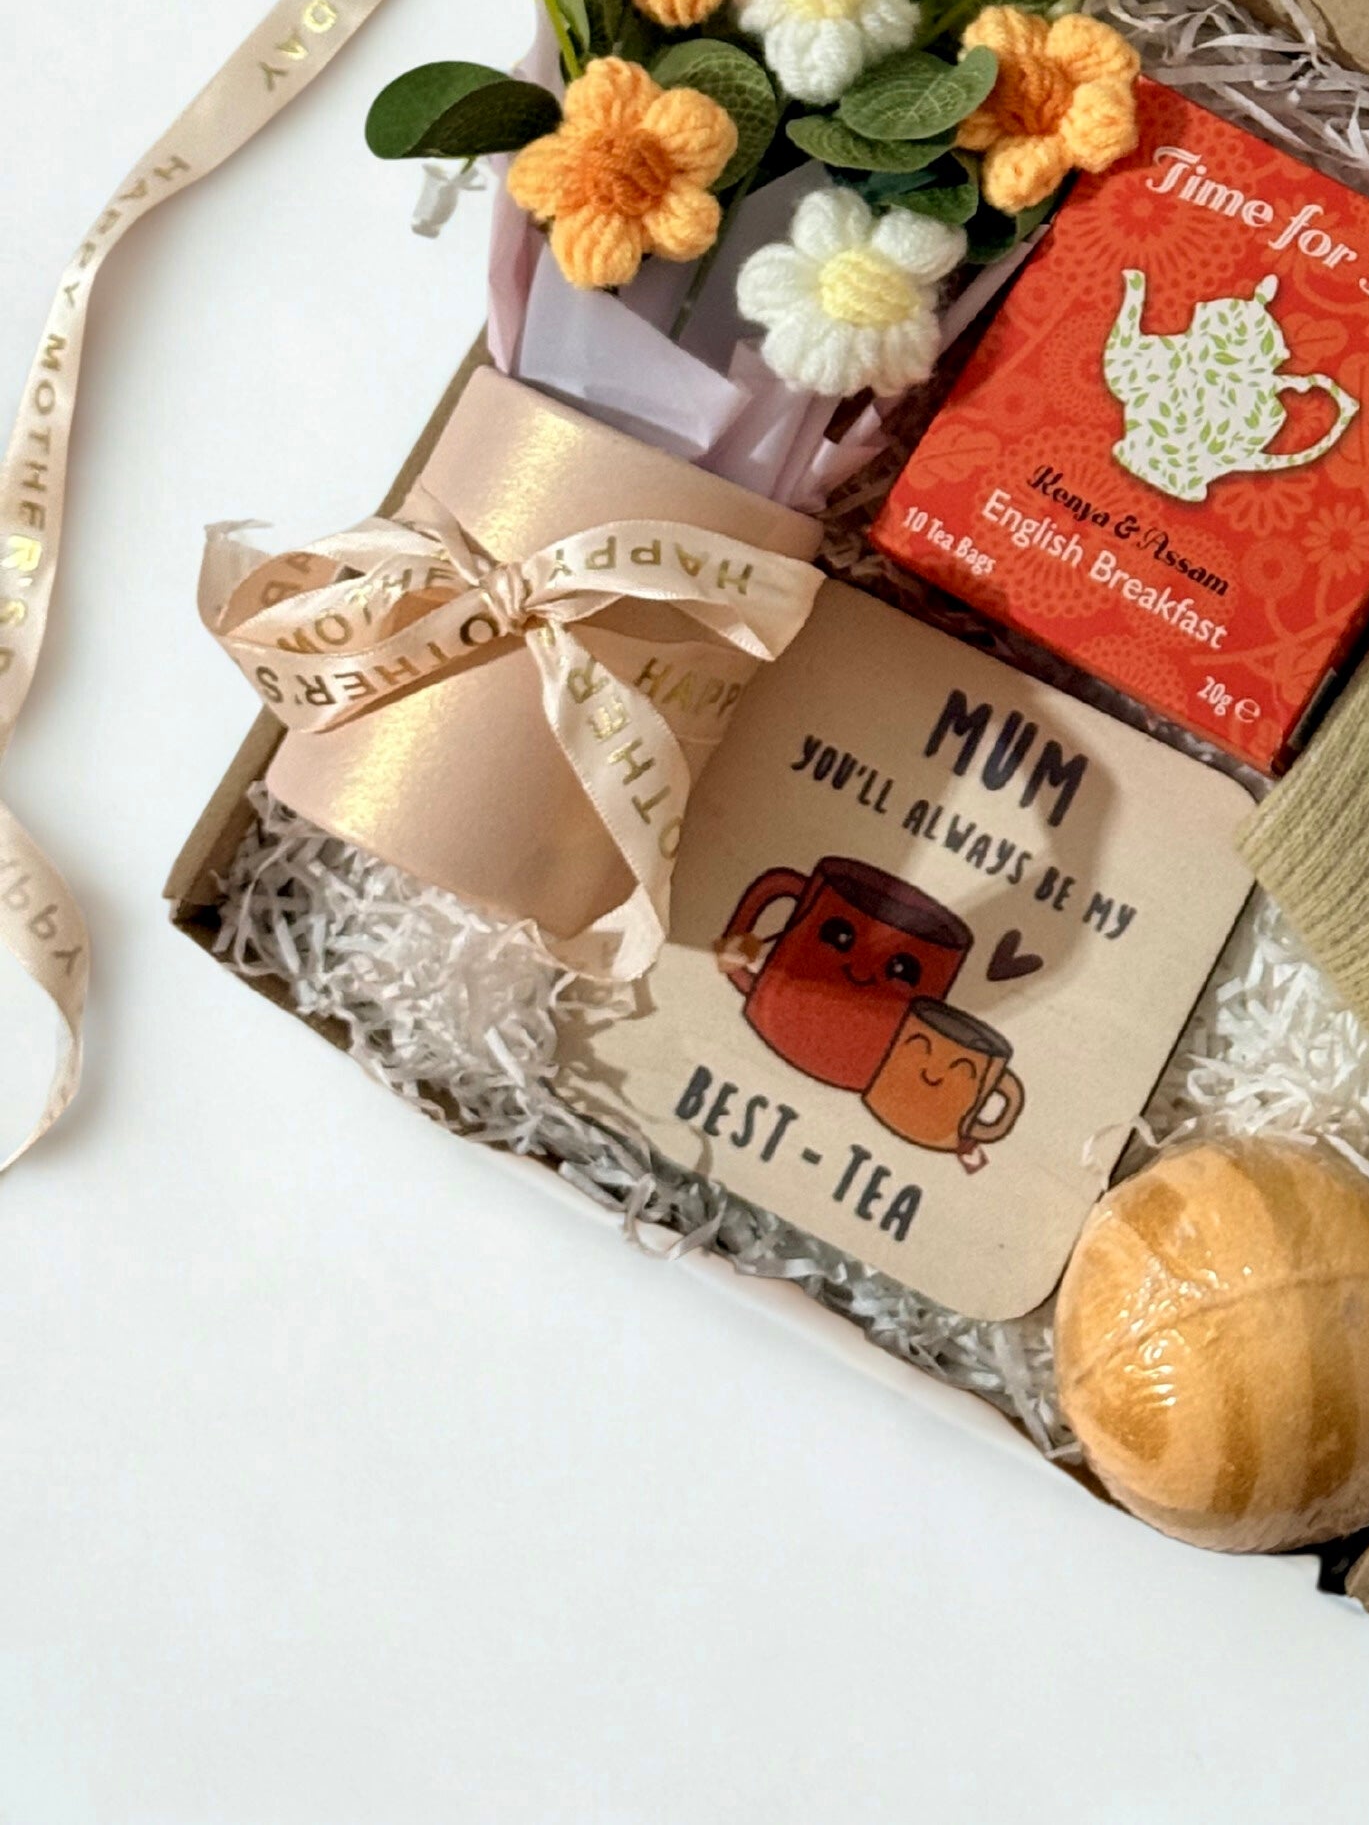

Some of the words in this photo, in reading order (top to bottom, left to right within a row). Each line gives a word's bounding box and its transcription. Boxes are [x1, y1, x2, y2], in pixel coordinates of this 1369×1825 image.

[62, 155, 191, 308] HAPPY
[1146, 146, 1274, 230] Time
[1269, 203, 1357, 270] for
[548, 535, 755, 595] HAPPY
[903, 506, 930, 532] 10
[926, 518, 953, 551] Tea
[953, 535, 997, 576] Bags
[981, 488, 1084, 568] English
[1089, 549, 1228, 650] Breakfast
[1027, 464, 1111, 528] Kenya
[1113, 514, 1141, 540] &
[1136, 526, 1230, 596] Assam
[255, 613, 500, 707] OTHER'S
[633, 656, 743, 718] HAPP
[1197, 675, 1234, 717] 20g
[923, 687, 1090, 828] MUM
[790, 733, 894, 815] YOU'LL
[902, 798, 1034, 885] ALWAYS
[1034, 866, 1074, 912] BE
[1083, 890, 1138, 941] MY
[673, 1063, 800, 1165] BEST
[831, 1143, 924, 1243] TEA
